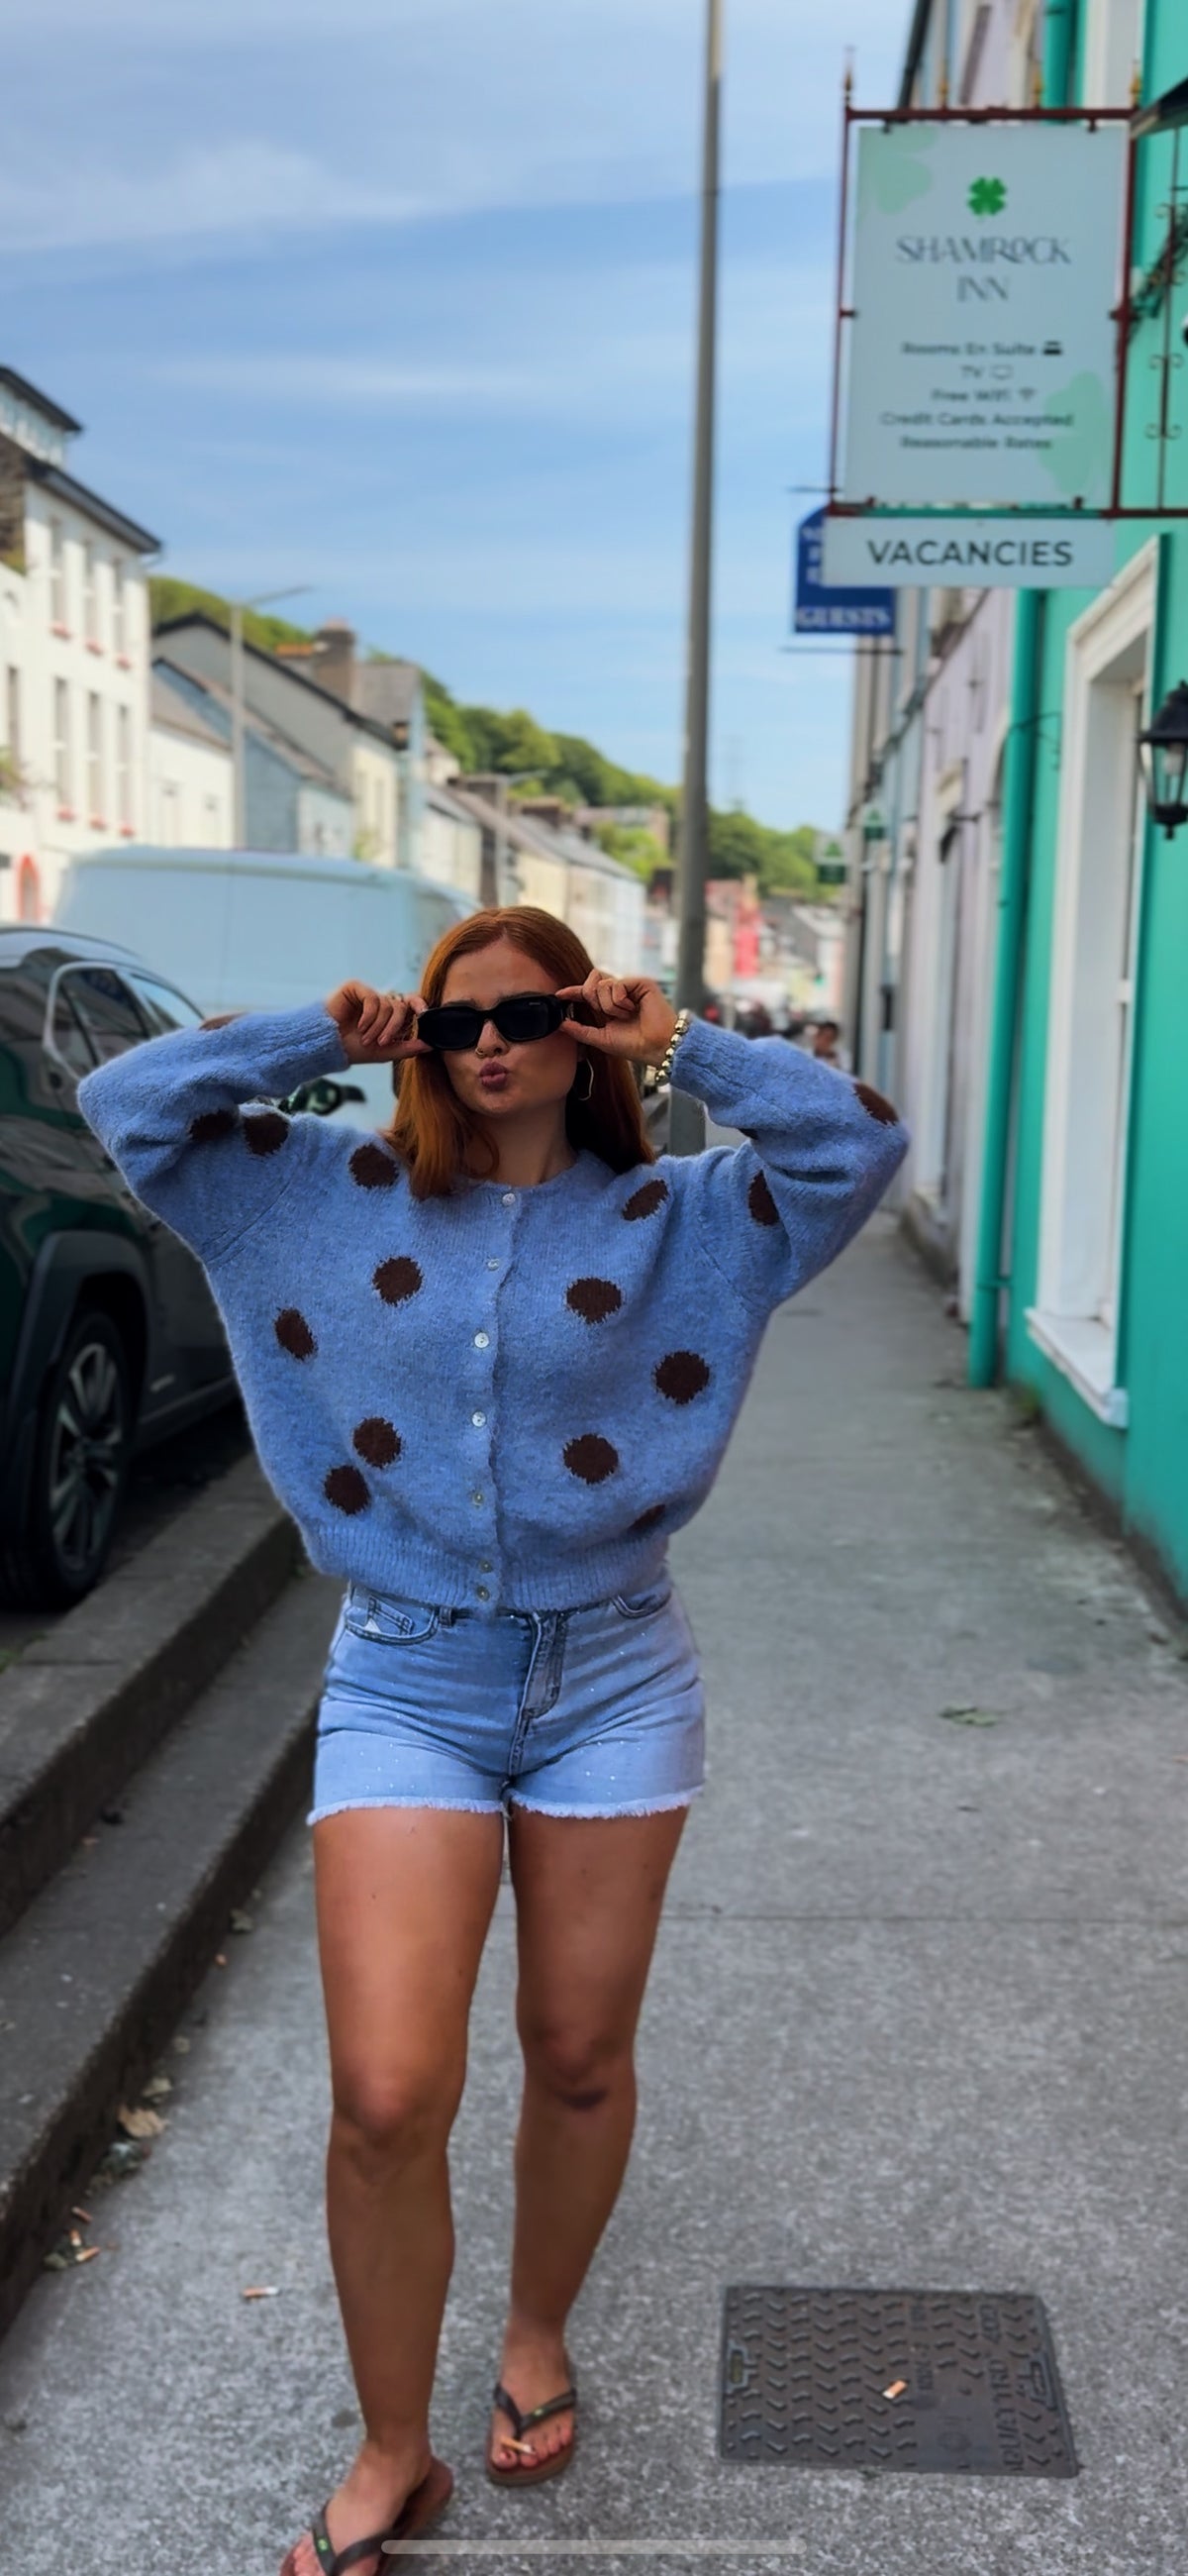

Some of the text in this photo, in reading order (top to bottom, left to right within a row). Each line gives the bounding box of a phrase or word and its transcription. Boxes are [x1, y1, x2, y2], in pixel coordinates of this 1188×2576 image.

[895, 237, 1071, 264] SHAMROCK
[957, 276, 1010, 302] INN
[902, 344, 1036, 356] Rooms En Suite
[961, 365, 982, 378] TV
[932, 389, 969, 401] Free
[881, 412, 1074, 428] Credit Cards Accepted
[901, 436, 1052, 449] Reasonable Rates
[866, 540, 1073, 567] VACANCIES
